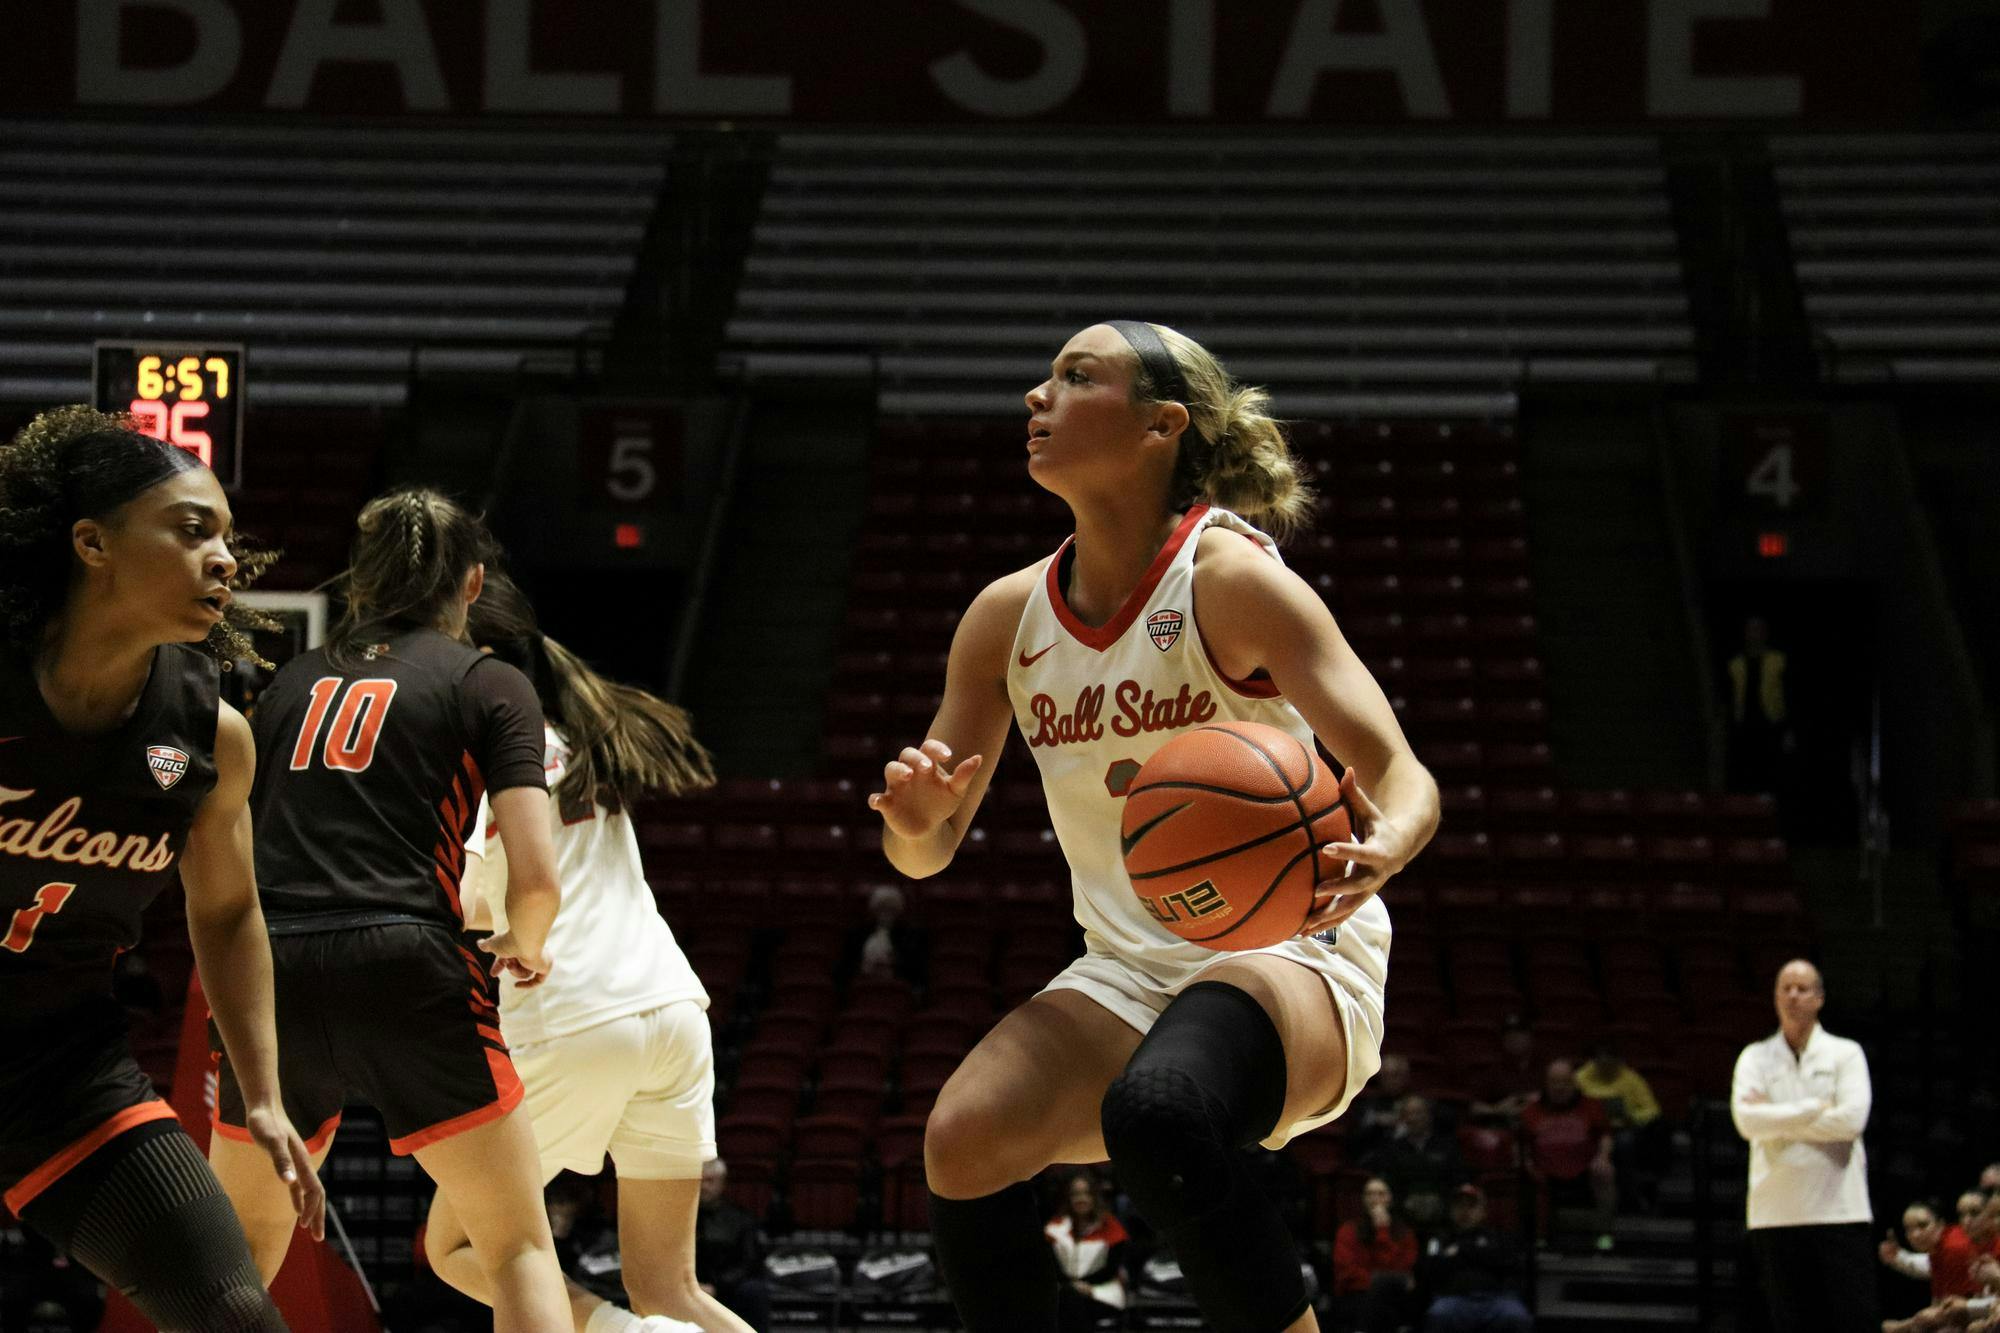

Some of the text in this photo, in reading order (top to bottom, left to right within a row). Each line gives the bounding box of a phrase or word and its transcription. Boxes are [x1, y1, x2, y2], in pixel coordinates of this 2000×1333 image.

[138, 356, 229, 400] 6:57
[605, 437, 656, 501] 5
[1744, 445, 1800, 507] 4
[1149, 621, 1182, 636] MAC
[290, 676, 398, 773] 10
[1029, 679, 1218, 748] Ball State
[150, 757, 185, 773] MAC
[0, 881, 77, 953] 1
